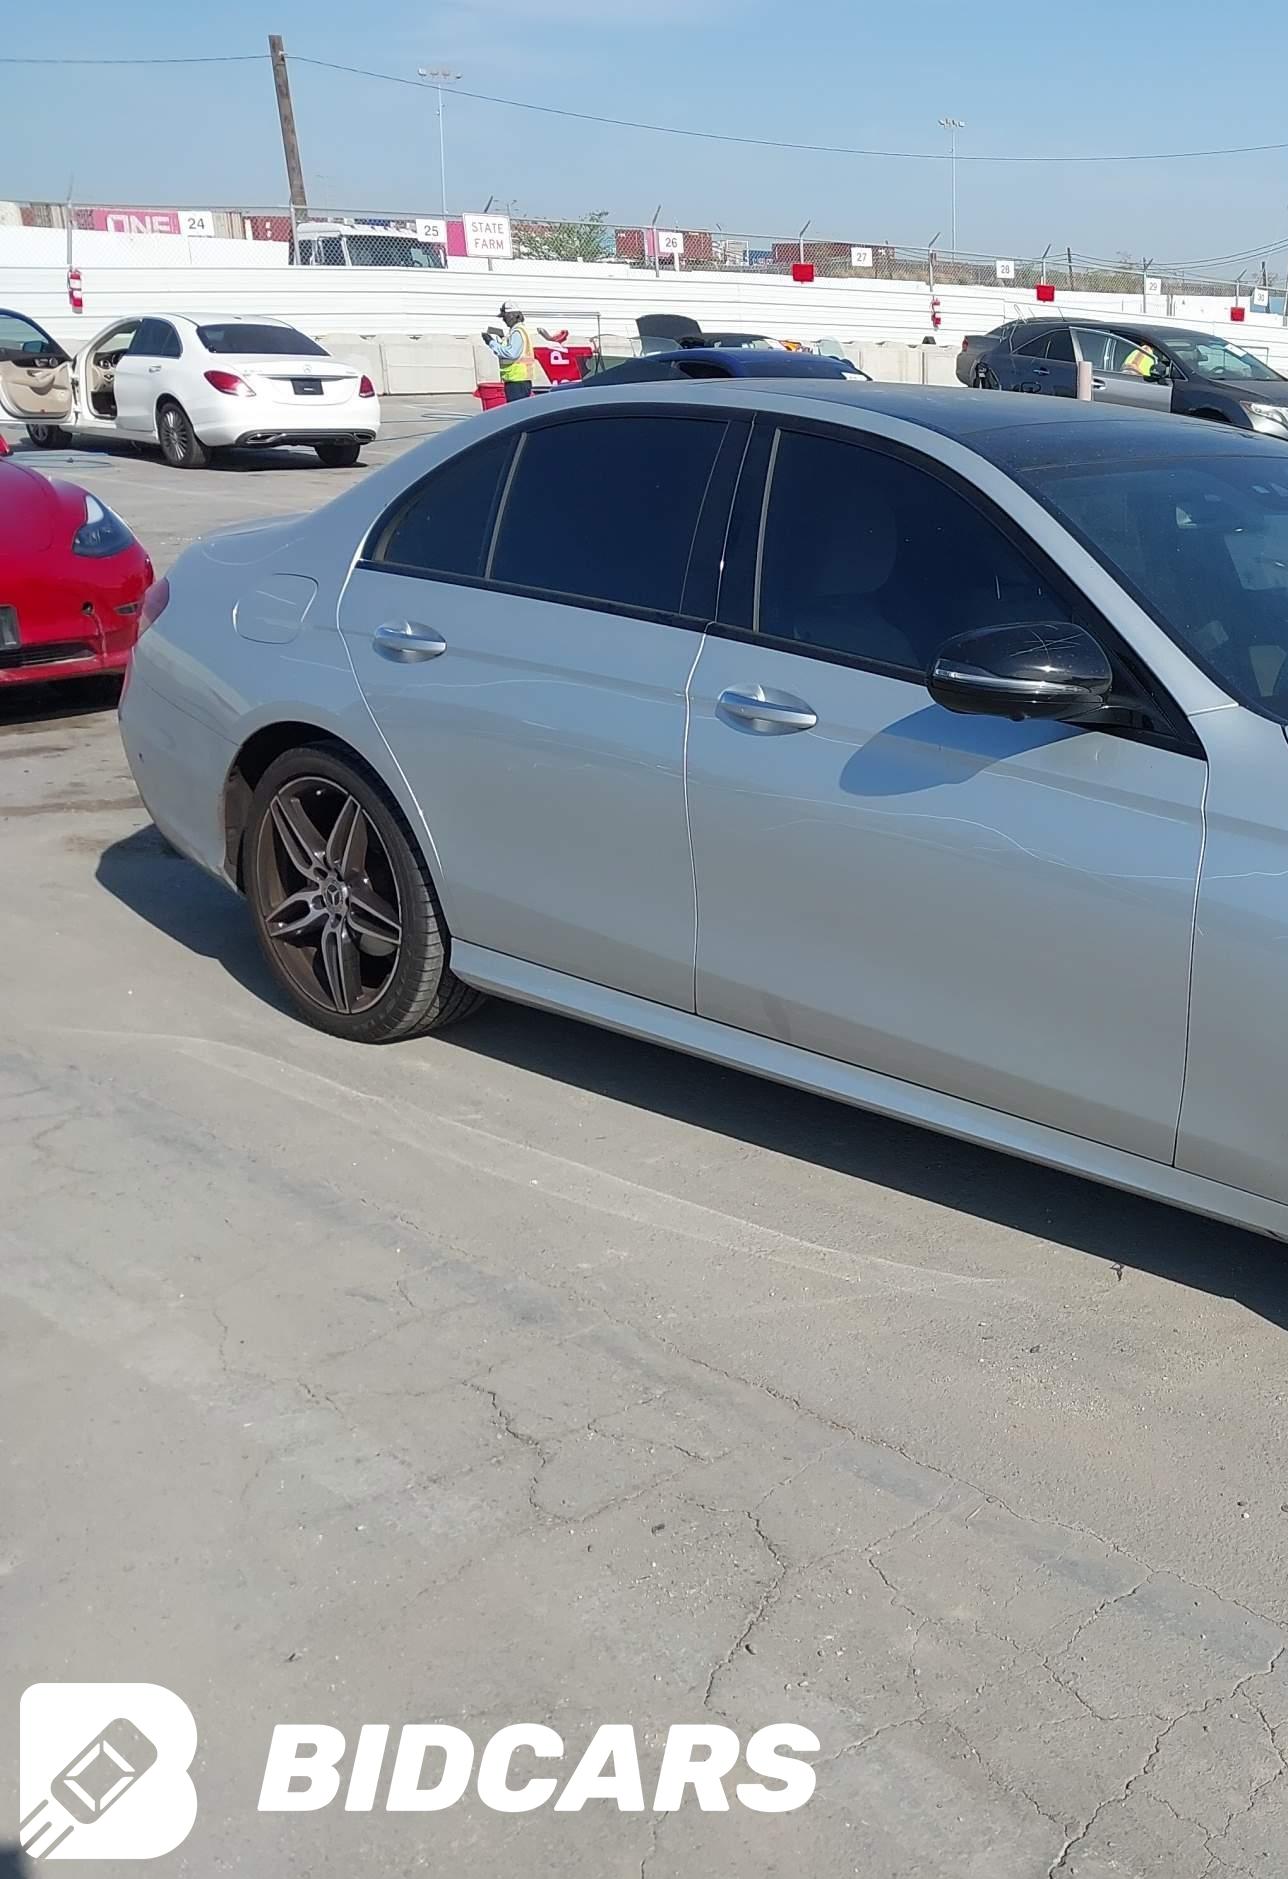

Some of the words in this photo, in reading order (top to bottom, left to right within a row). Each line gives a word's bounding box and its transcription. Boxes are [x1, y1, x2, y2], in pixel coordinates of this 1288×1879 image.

[106, 214, 171, 233] ONE
[187, 217, 205, 230] 24
[471, 221, 505, 234] STATE
[423, 224, 439, 237] 25
[474, 238, 504, 250] FARM
[664, 237, 678, 249] 26
[856, 252, 868, 263] 27
[1000, 264, 1010, 275] 28
